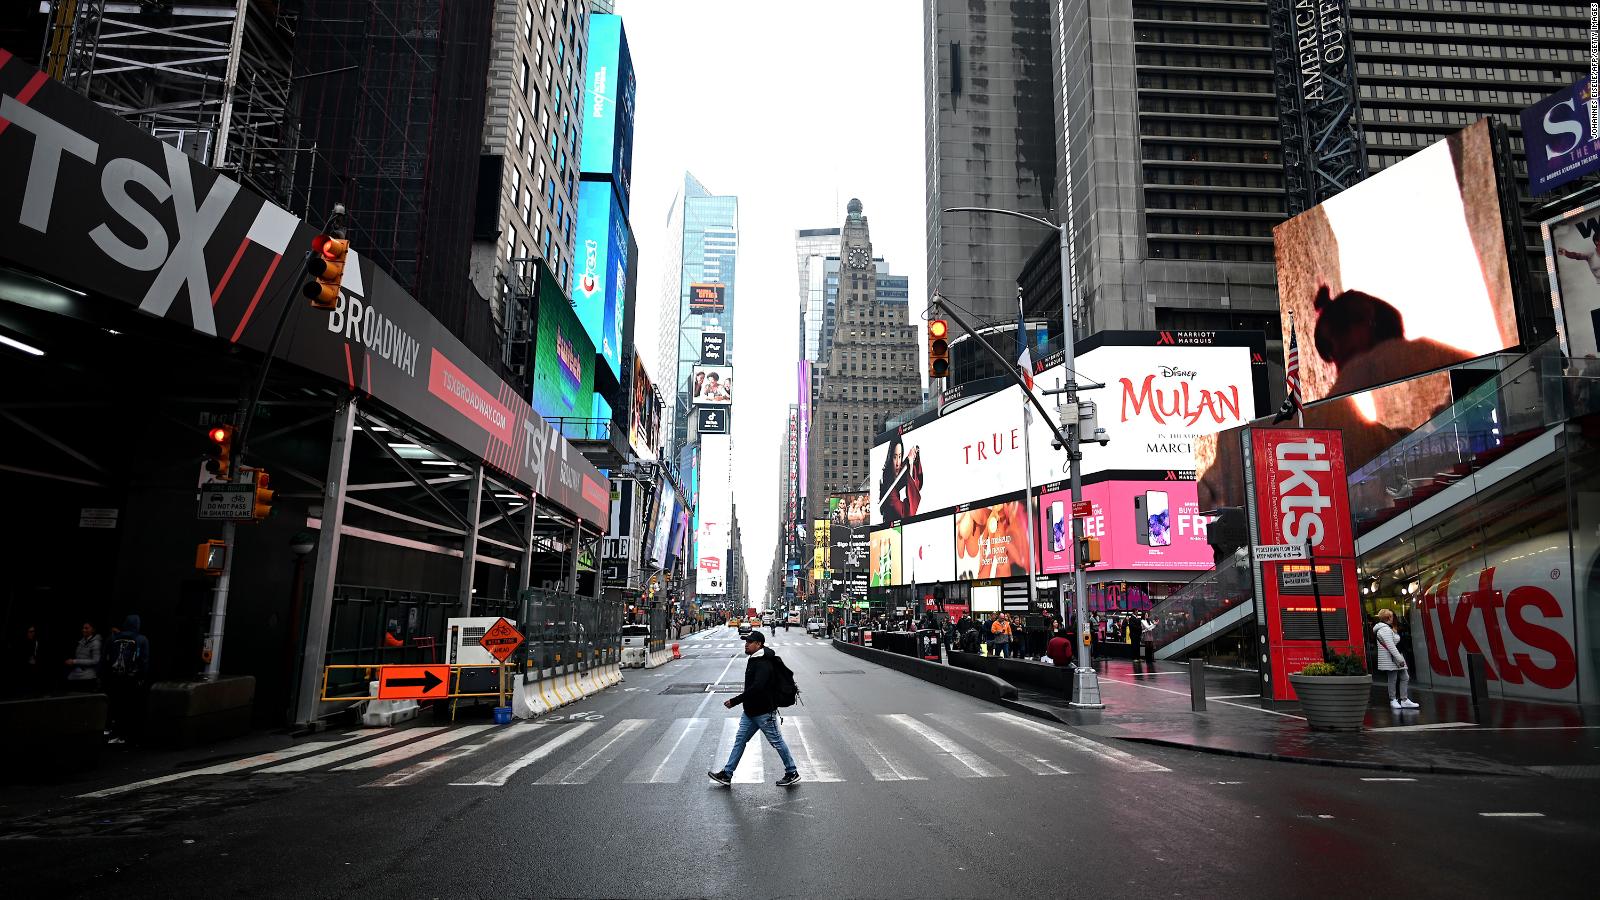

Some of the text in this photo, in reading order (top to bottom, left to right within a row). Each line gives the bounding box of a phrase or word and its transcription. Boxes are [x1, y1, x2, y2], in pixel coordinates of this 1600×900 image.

[1570, 145, 1589, 161] THE
[0, 93, 241, 336] TSX
[583, 240, 597, 292] Crest
[328, 291, 420, 378] BROADWAY
[443, 368, 506, 429] TSXBROADWAY.COM
[523, 417, 549, 498] TSX
[963, 429, 1019, 464] TRUE
[1276, 438, 1331, 547] tkts
[1416, 566, 1576, 689] tkts
